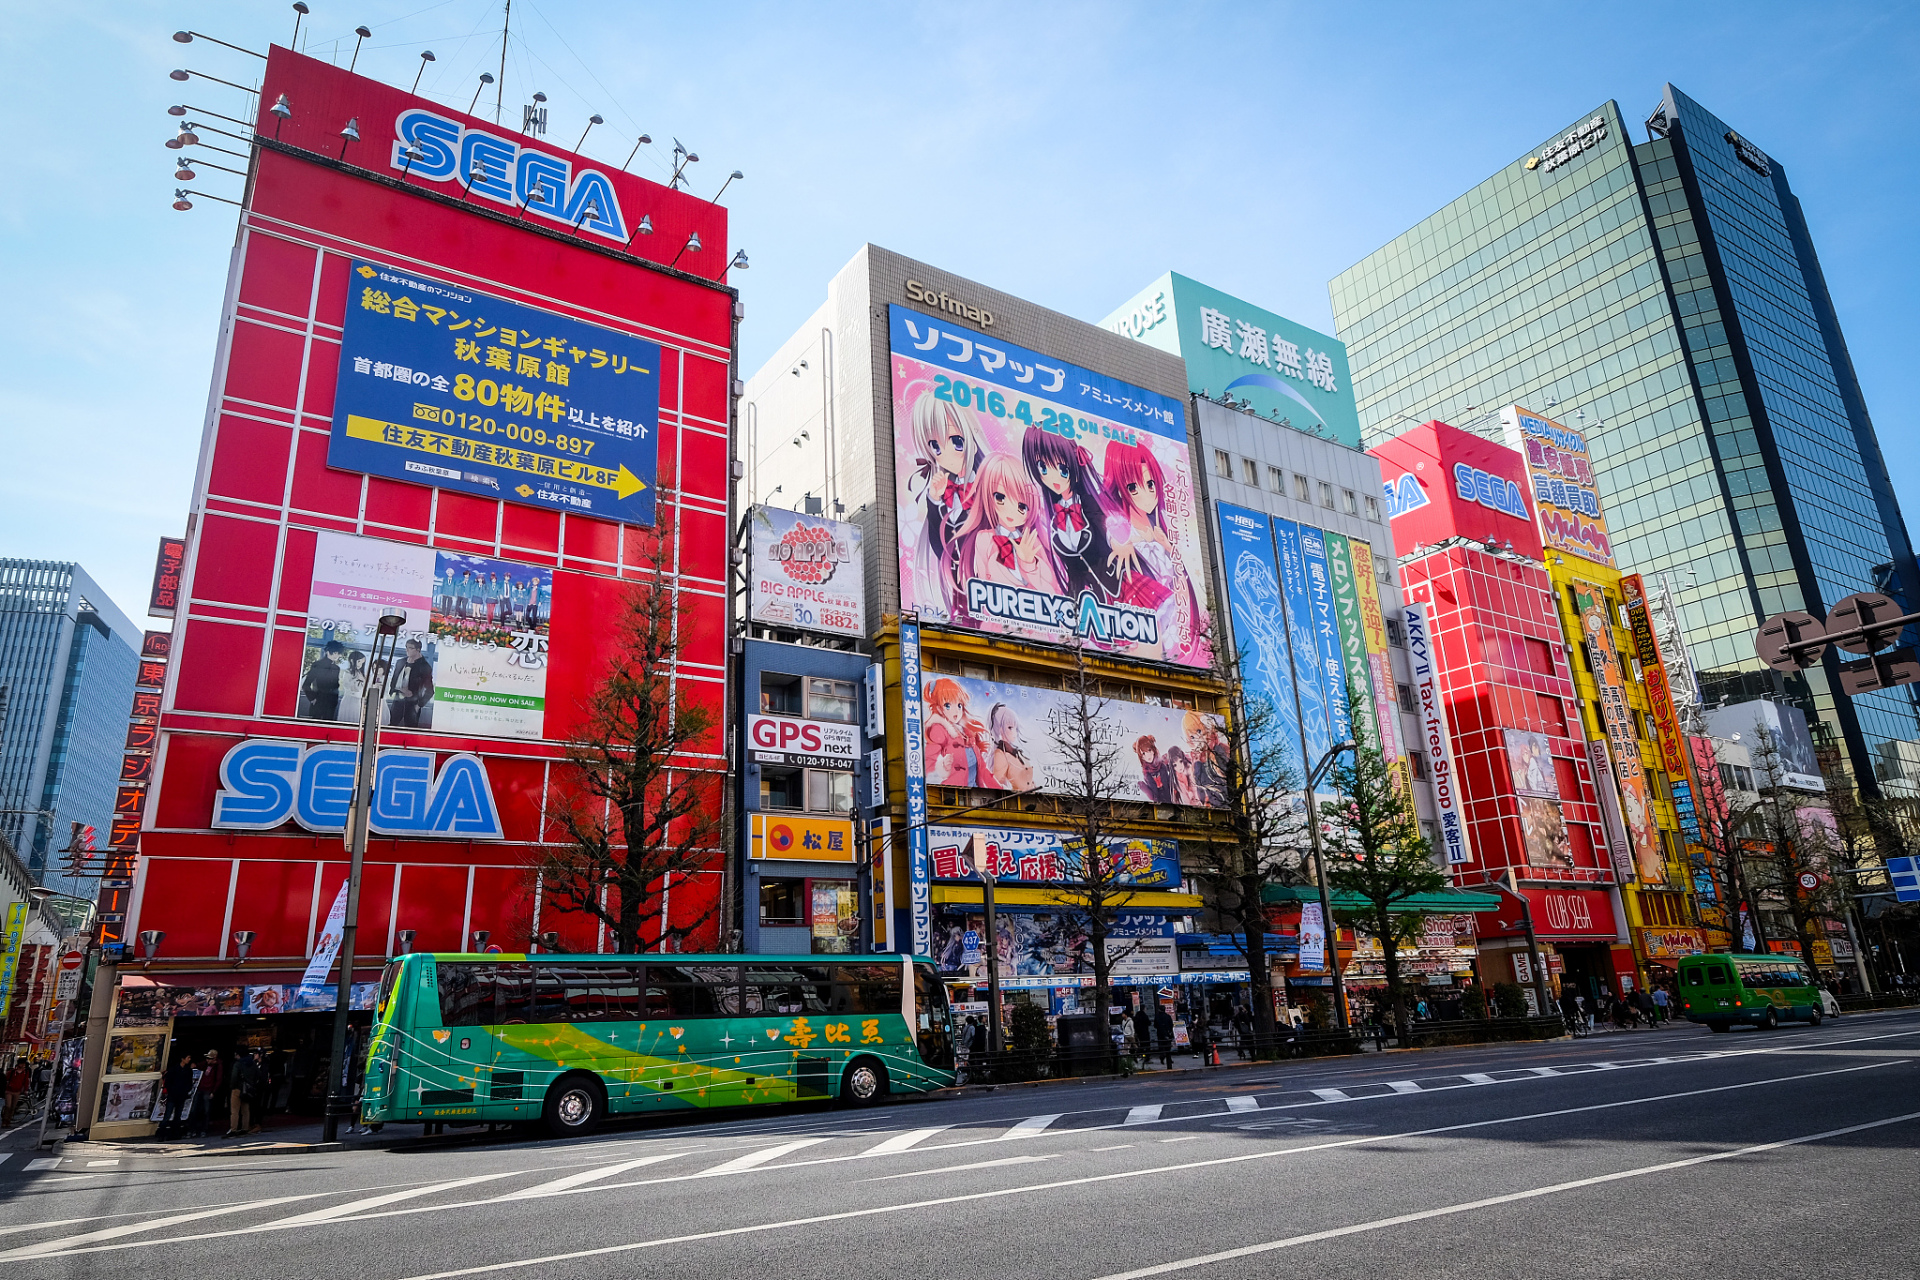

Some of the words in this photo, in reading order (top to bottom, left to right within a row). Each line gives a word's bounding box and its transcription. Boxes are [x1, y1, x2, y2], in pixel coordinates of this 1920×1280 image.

[390, 108, 632, 246] SEGA
[379, 272, 472, 303] 住友不動産のマンション
[906, 279, 994, 329] Sofmap
[361, 287, 650, 376] 総合マンションギャラリー
[455, 337, 570, 387] 秋葉原館
[904, 318, 1066, 393] ソフマップ
[1079, 382, 1175, 426] アミューズメント館
[353, 356, 450, 393] 首都圏の全
[453, 373, 566, 423] 80物件
[567, 406, 649, 440] 以上を紹介
[441, 408, 595, 456] 0120-009-897
[1078, 417, 1099, 435] ON
[1102, 425, 1138, 448] SALE
[381, 424, 619, 488] 住友不動産秋葉原ビル8F
[536, 489, 592, 510] 住友不動産
[1453, 462, 1531, 522] SEGA
[1533, 472, 1600, 519] 高額買取
[768, 543, 793, 562] BIG
[794, 540, 851, 563] APPLE
[1541, 509, 1612, 560] Mulan
[155, 542, 184, 607] 電子部品
[1164, 484, 1192, 641] 名前で呼んでいいかな
[339, 588, 358, 597] 4.23
[760, 580, 785, 596] BIG
[903, 642, 919, 698] 売るのも
[520, 699, 536, 707] SALE
[753, 719, 822, 751] GPS
[824, 743, 853, 755] next
[907, 717, 922, 777] 買うのも
[1419, 677, 1444, 757] Tax-free
[1434, 759, 1452, 809] Shop
[797, 756, 853, 768] 0120-915-047
[1593, 745, 1608, 775] GAME
[100, 661, 166, 946] 東京ラジオデパート
[211, 738, 504, 839] SEGA
[802, 829, 844, 851] 松屋
[999, 832, 1056, 846] ソフマップ
[874, 878, 885, 920] 松屋
[1802, 876, 1815, 885] 50
[913, 885, 929, 955] ソフマップ
[1425, 916, 1453, 935] Shop
[1546, 895, 1570, 929] CLUB
[1568, 895, 1593, 929] SEGA
[964, 936, 977, 945] 437
[1663, 929, 1695, 950] Mulan
[1520, 952, 1531, 983] GAME
